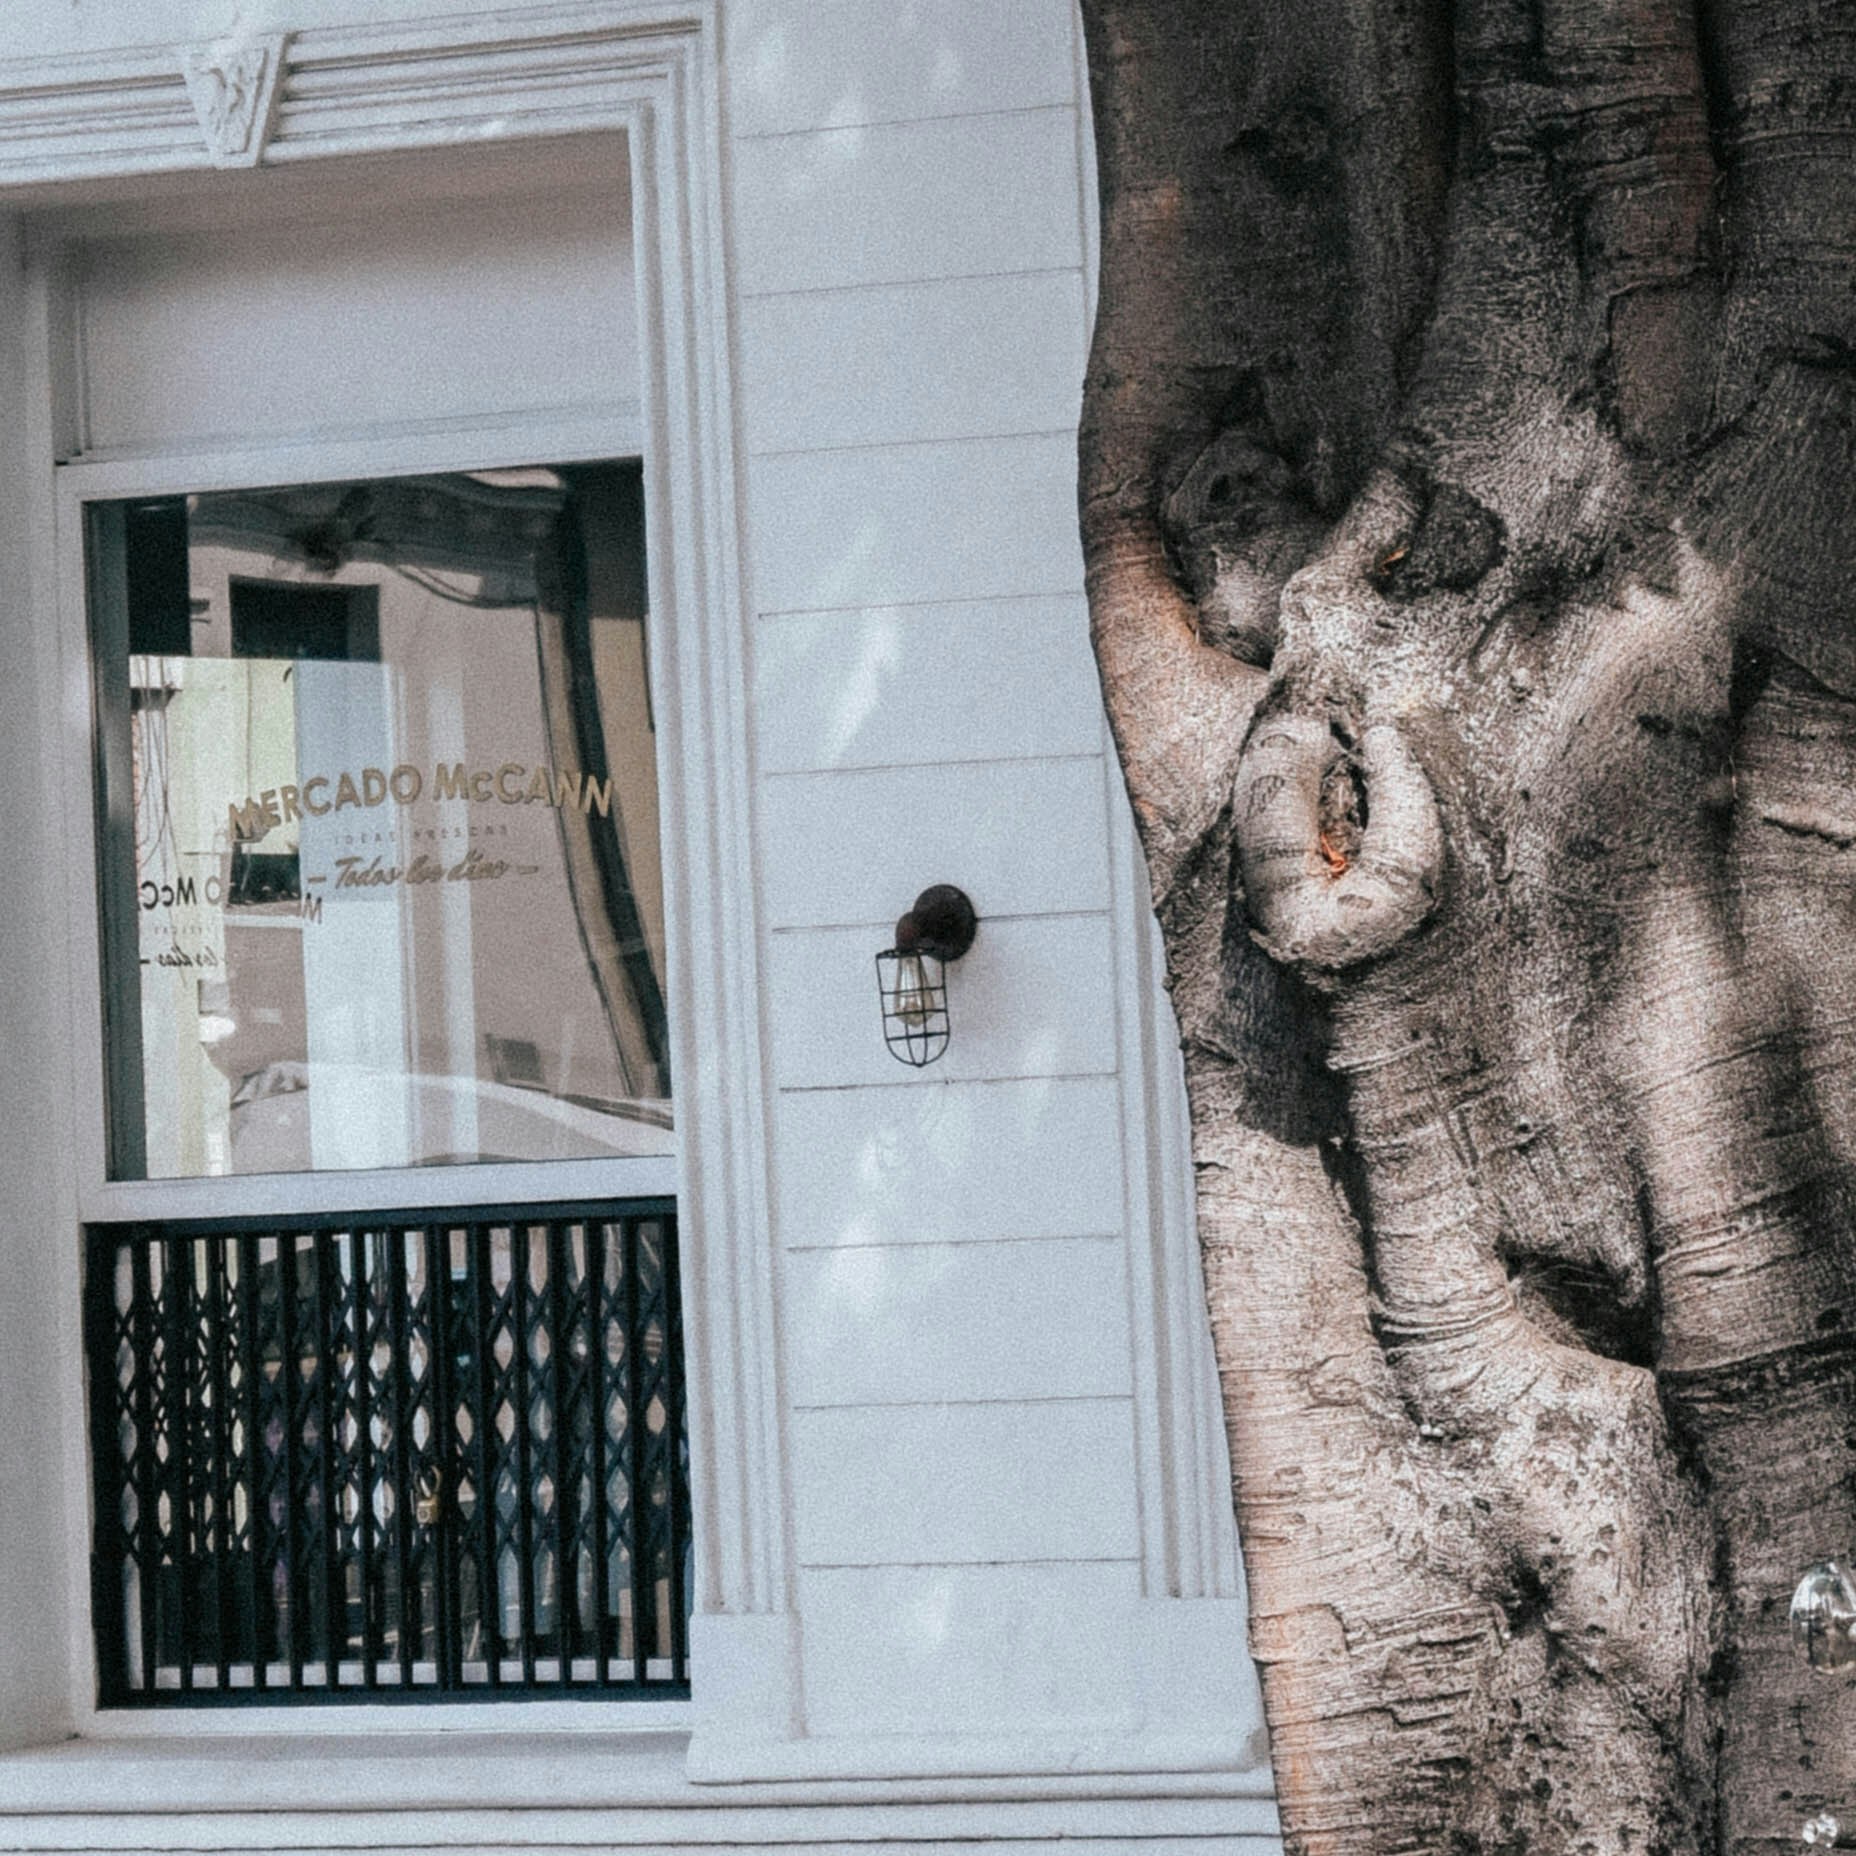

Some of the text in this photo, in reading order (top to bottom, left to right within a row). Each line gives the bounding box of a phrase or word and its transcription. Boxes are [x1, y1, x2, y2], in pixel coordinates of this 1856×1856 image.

[228, 762, 614, 840] MERCADO McCANN
[334, 855, 402, 889] Todos
[405, 853, 443, 884] los
